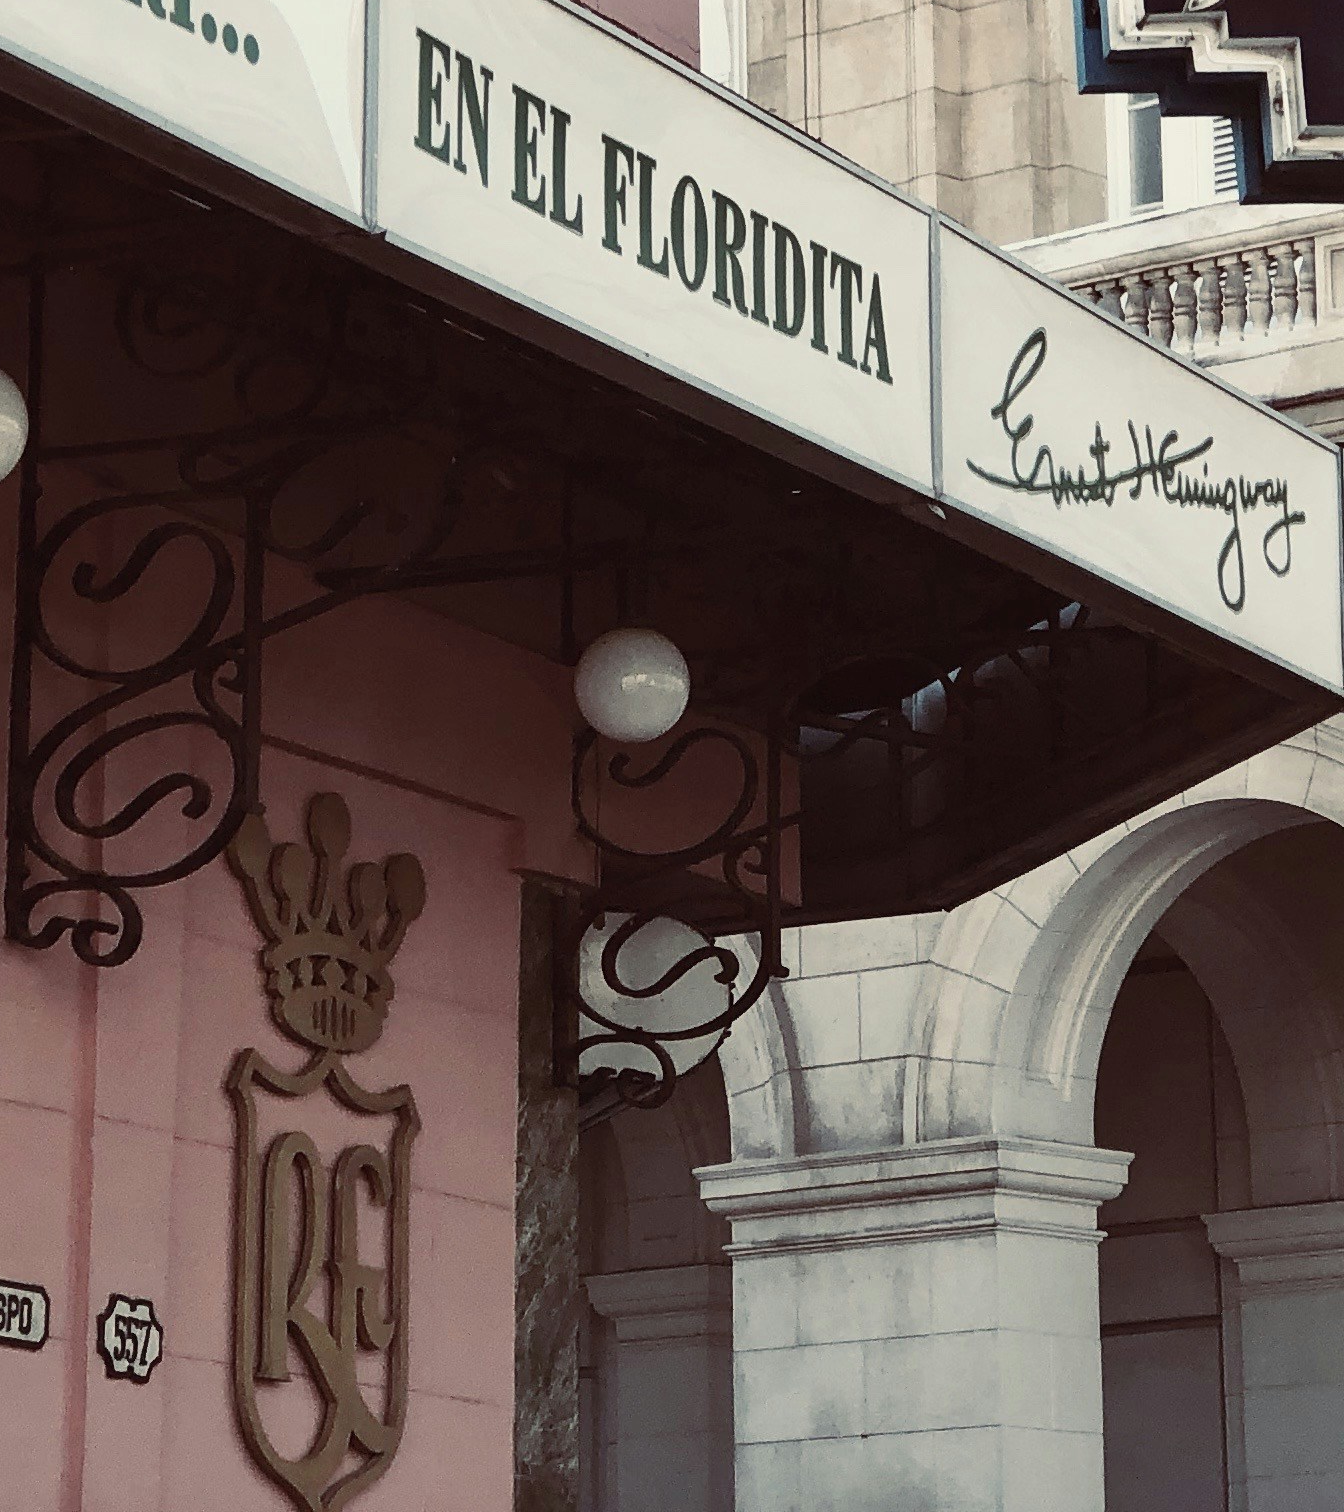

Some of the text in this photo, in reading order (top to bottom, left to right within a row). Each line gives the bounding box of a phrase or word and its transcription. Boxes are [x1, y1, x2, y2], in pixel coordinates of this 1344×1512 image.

[413, 27, 895, 387] EN EL FLORIDITA
[113, 1314, 152, 1367] 557
